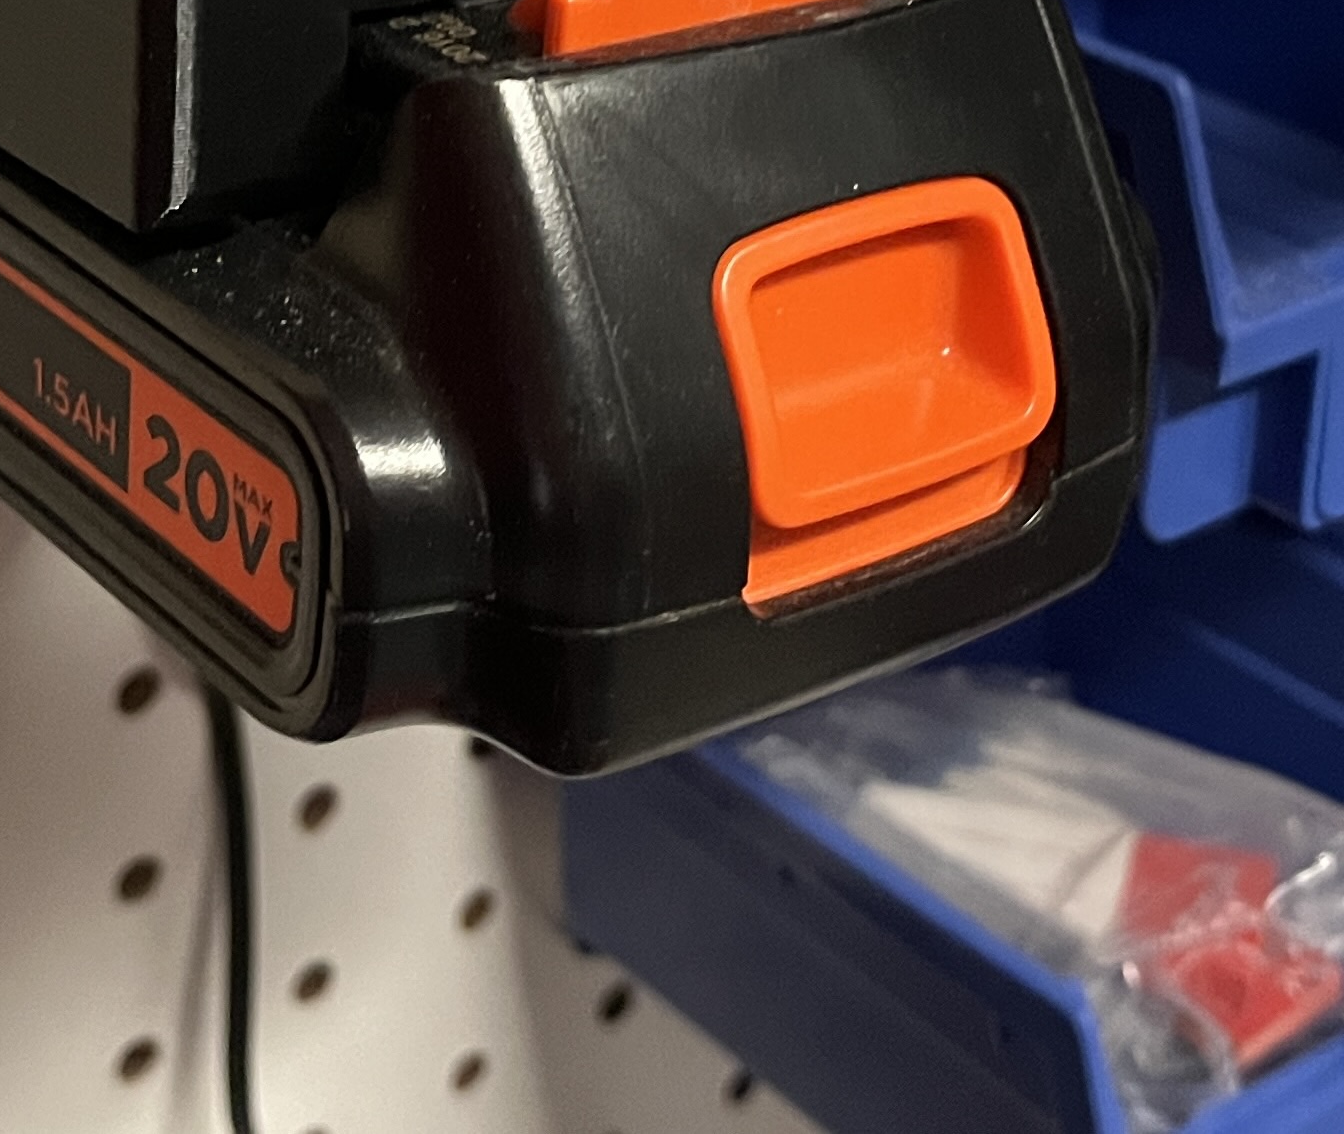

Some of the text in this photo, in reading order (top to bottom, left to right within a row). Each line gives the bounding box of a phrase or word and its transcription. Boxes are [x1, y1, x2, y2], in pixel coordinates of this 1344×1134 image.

[33, 357, 117, 456] 1.5AH
[143, 414, 271, 576] 20V
[233, 472, 273, 517] MAX
